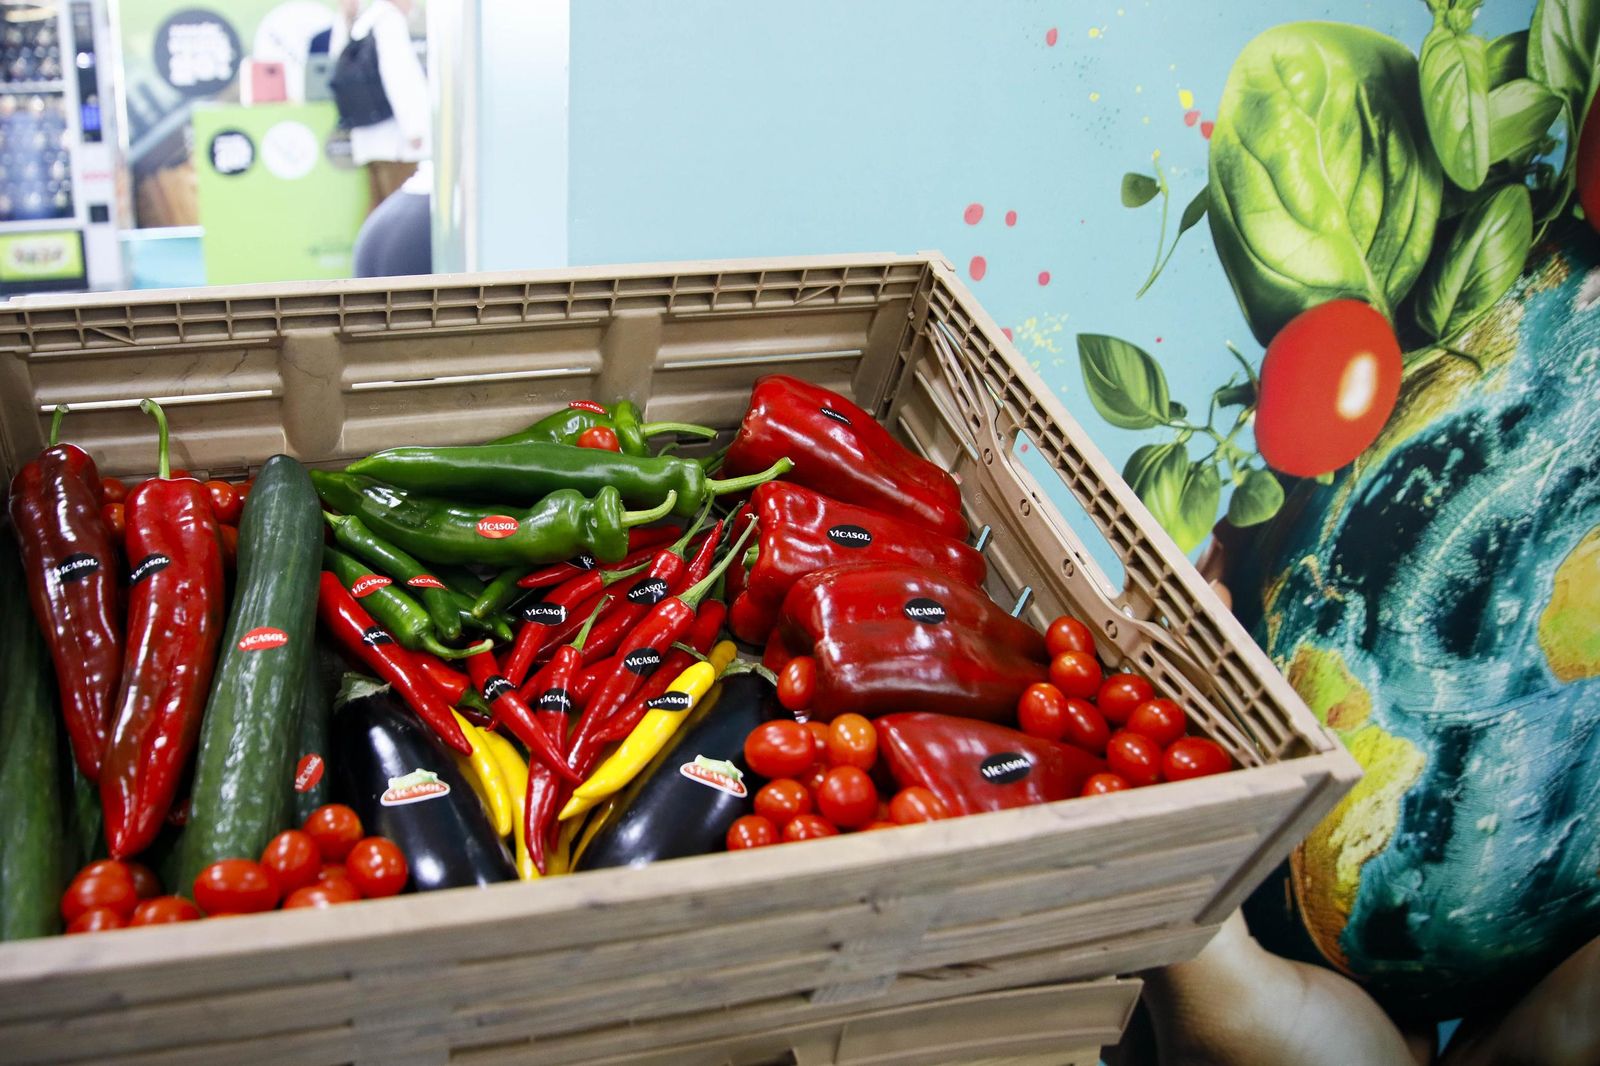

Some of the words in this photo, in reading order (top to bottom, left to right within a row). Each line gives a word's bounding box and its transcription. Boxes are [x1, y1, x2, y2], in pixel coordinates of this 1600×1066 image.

[478, 521, 519, 531] VICASOL
[829, 529, 871, 541] VICASOL
[131, 557, 169, 580] VICASOL
[351, 578, 391, 594] VICASOL
[628, 582, 667, 599] VICASOL
[905, 606, 946, 616] VICASOL
[239, 633, 288, 649] VICASOL
[626, 655, 661, 666] VICASOL
[294, 756, 322, 790] VICASOL
[982, 758, 1031, 778] VICASOL
